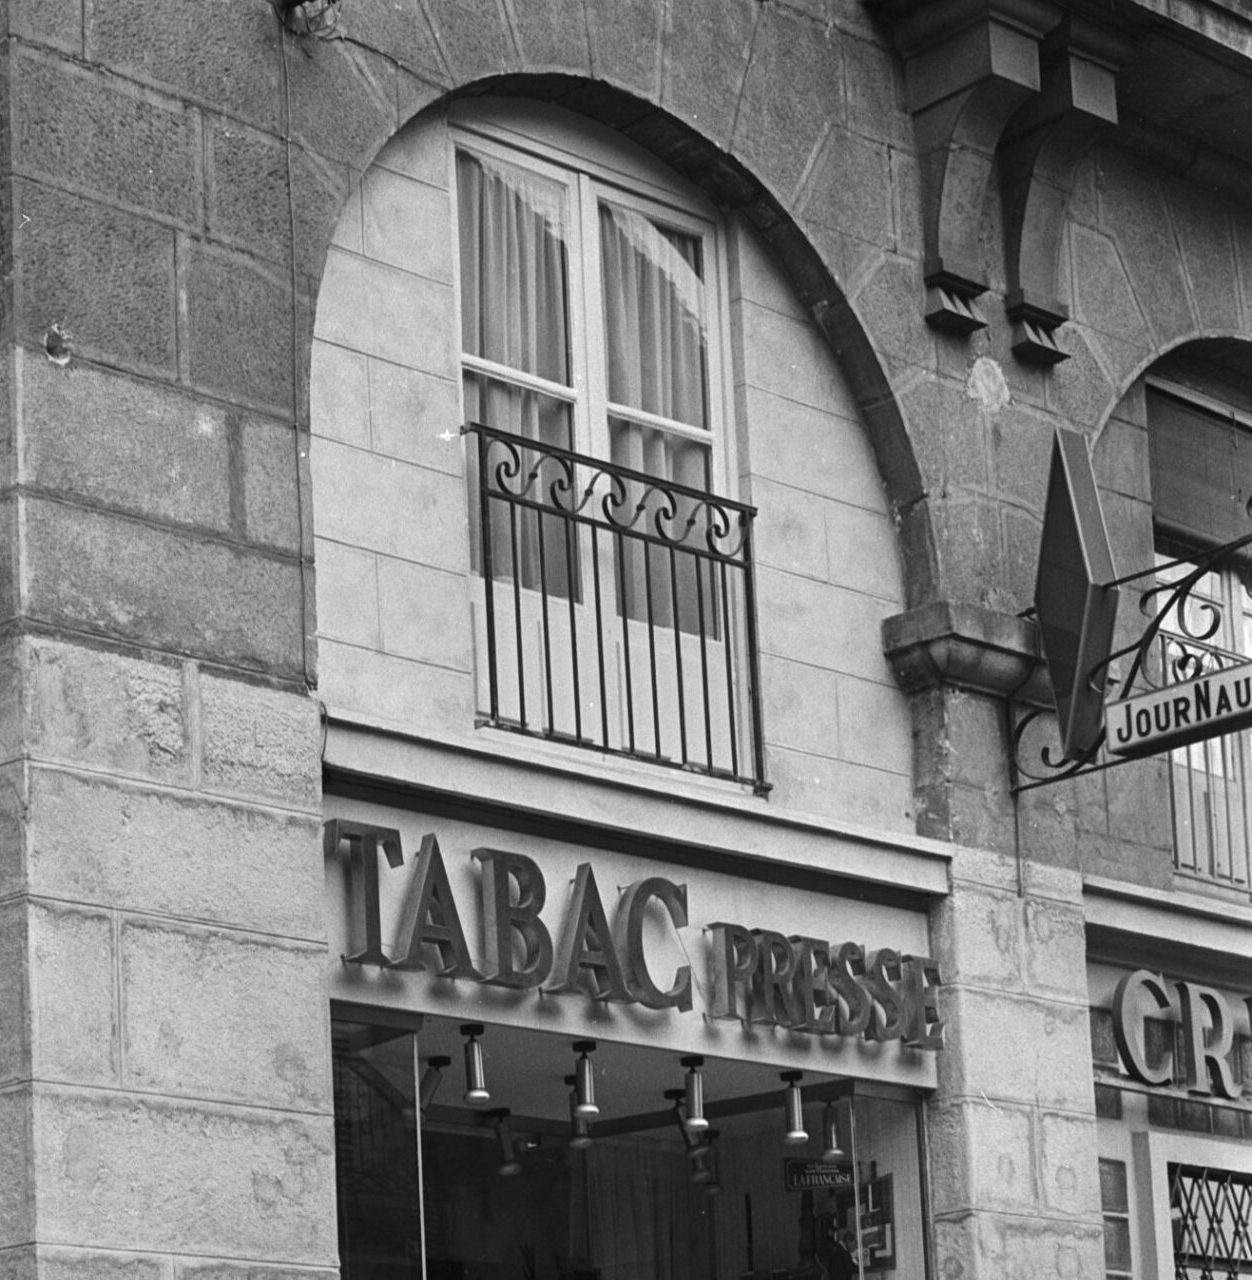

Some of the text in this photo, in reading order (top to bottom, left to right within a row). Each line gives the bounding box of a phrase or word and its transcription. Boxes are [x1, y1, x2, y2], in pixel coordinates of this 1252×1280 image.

[324, 818, 945, 1051] TABAC PRESSE
[1113, 969, 1252, 1100] CR
